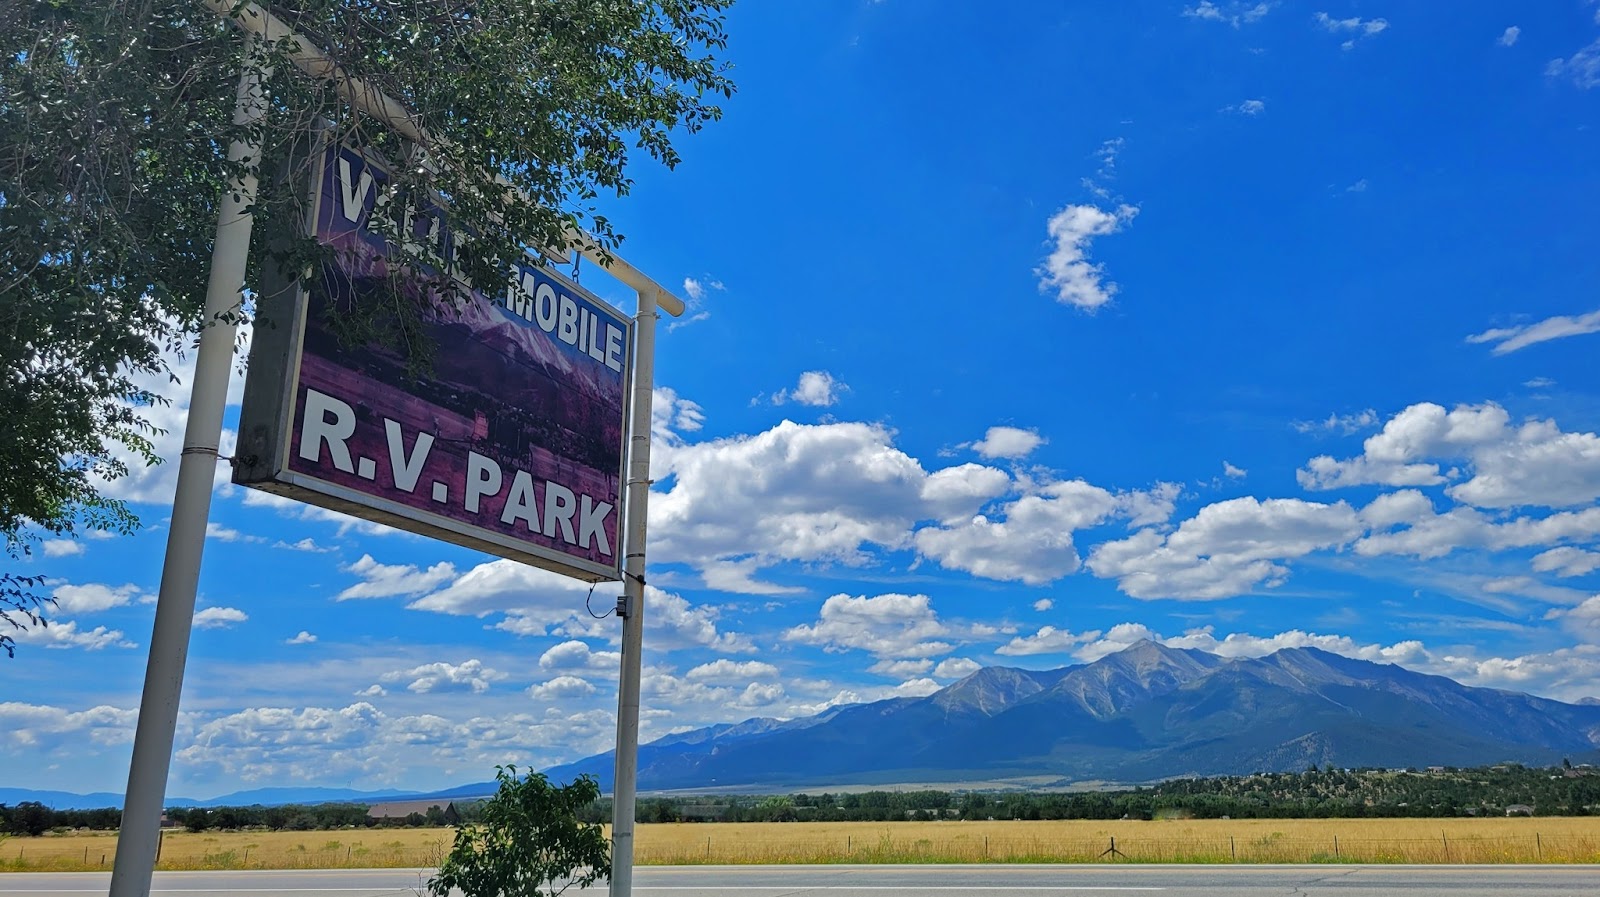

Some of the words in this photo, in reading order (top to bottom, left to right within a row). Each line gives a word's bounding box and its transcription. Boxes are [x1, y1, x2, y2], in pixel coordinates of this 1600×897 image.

[506, 263, 623, 373] MOBILE
[299, 388, 449, 504] R.V.
[464, 450, 614, 557] PARK
